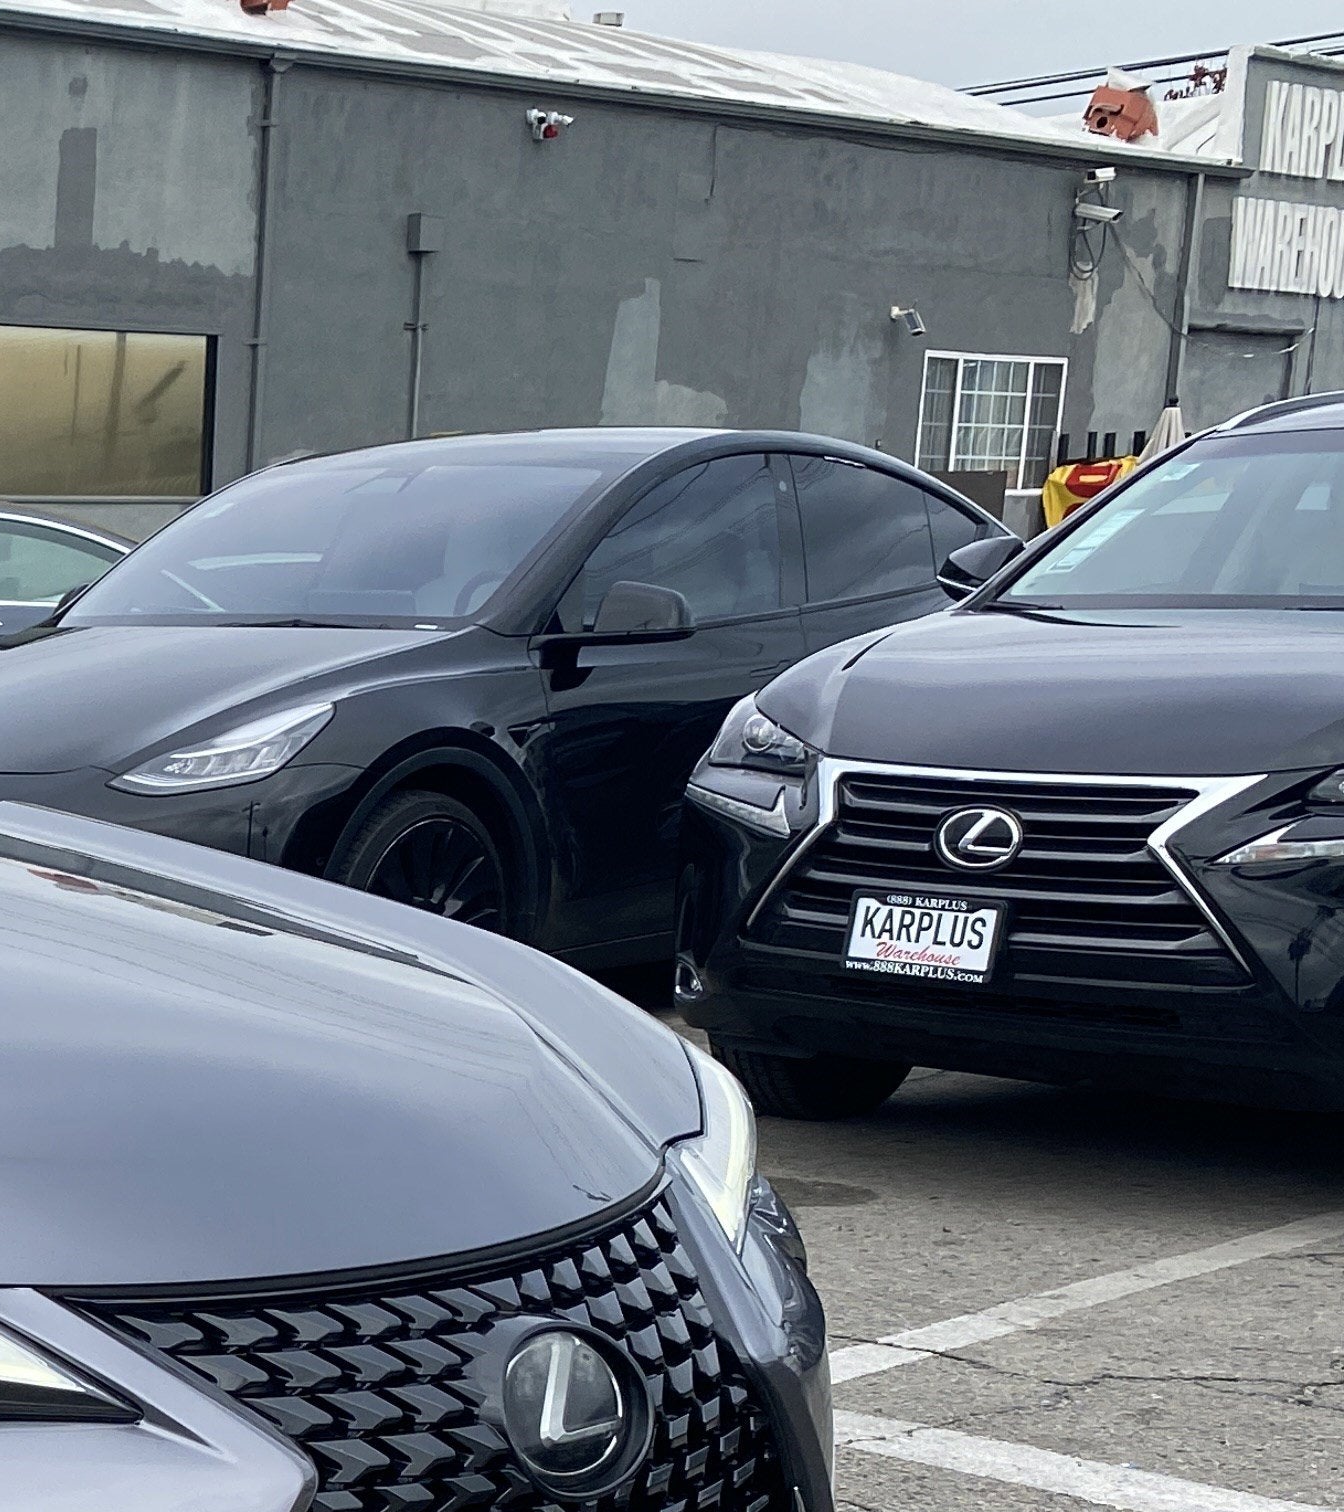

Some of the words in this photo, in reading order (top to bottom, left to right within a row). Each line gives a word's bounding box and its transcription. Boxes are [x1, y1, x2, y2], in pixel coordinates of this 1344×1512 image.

[886, 894, 912, 905] (888)
[915, 896, 968, 911] KARPLUS
[860, 905, 987, 950] KARPLUS
[876, 941, 961, 966] Warehouse
